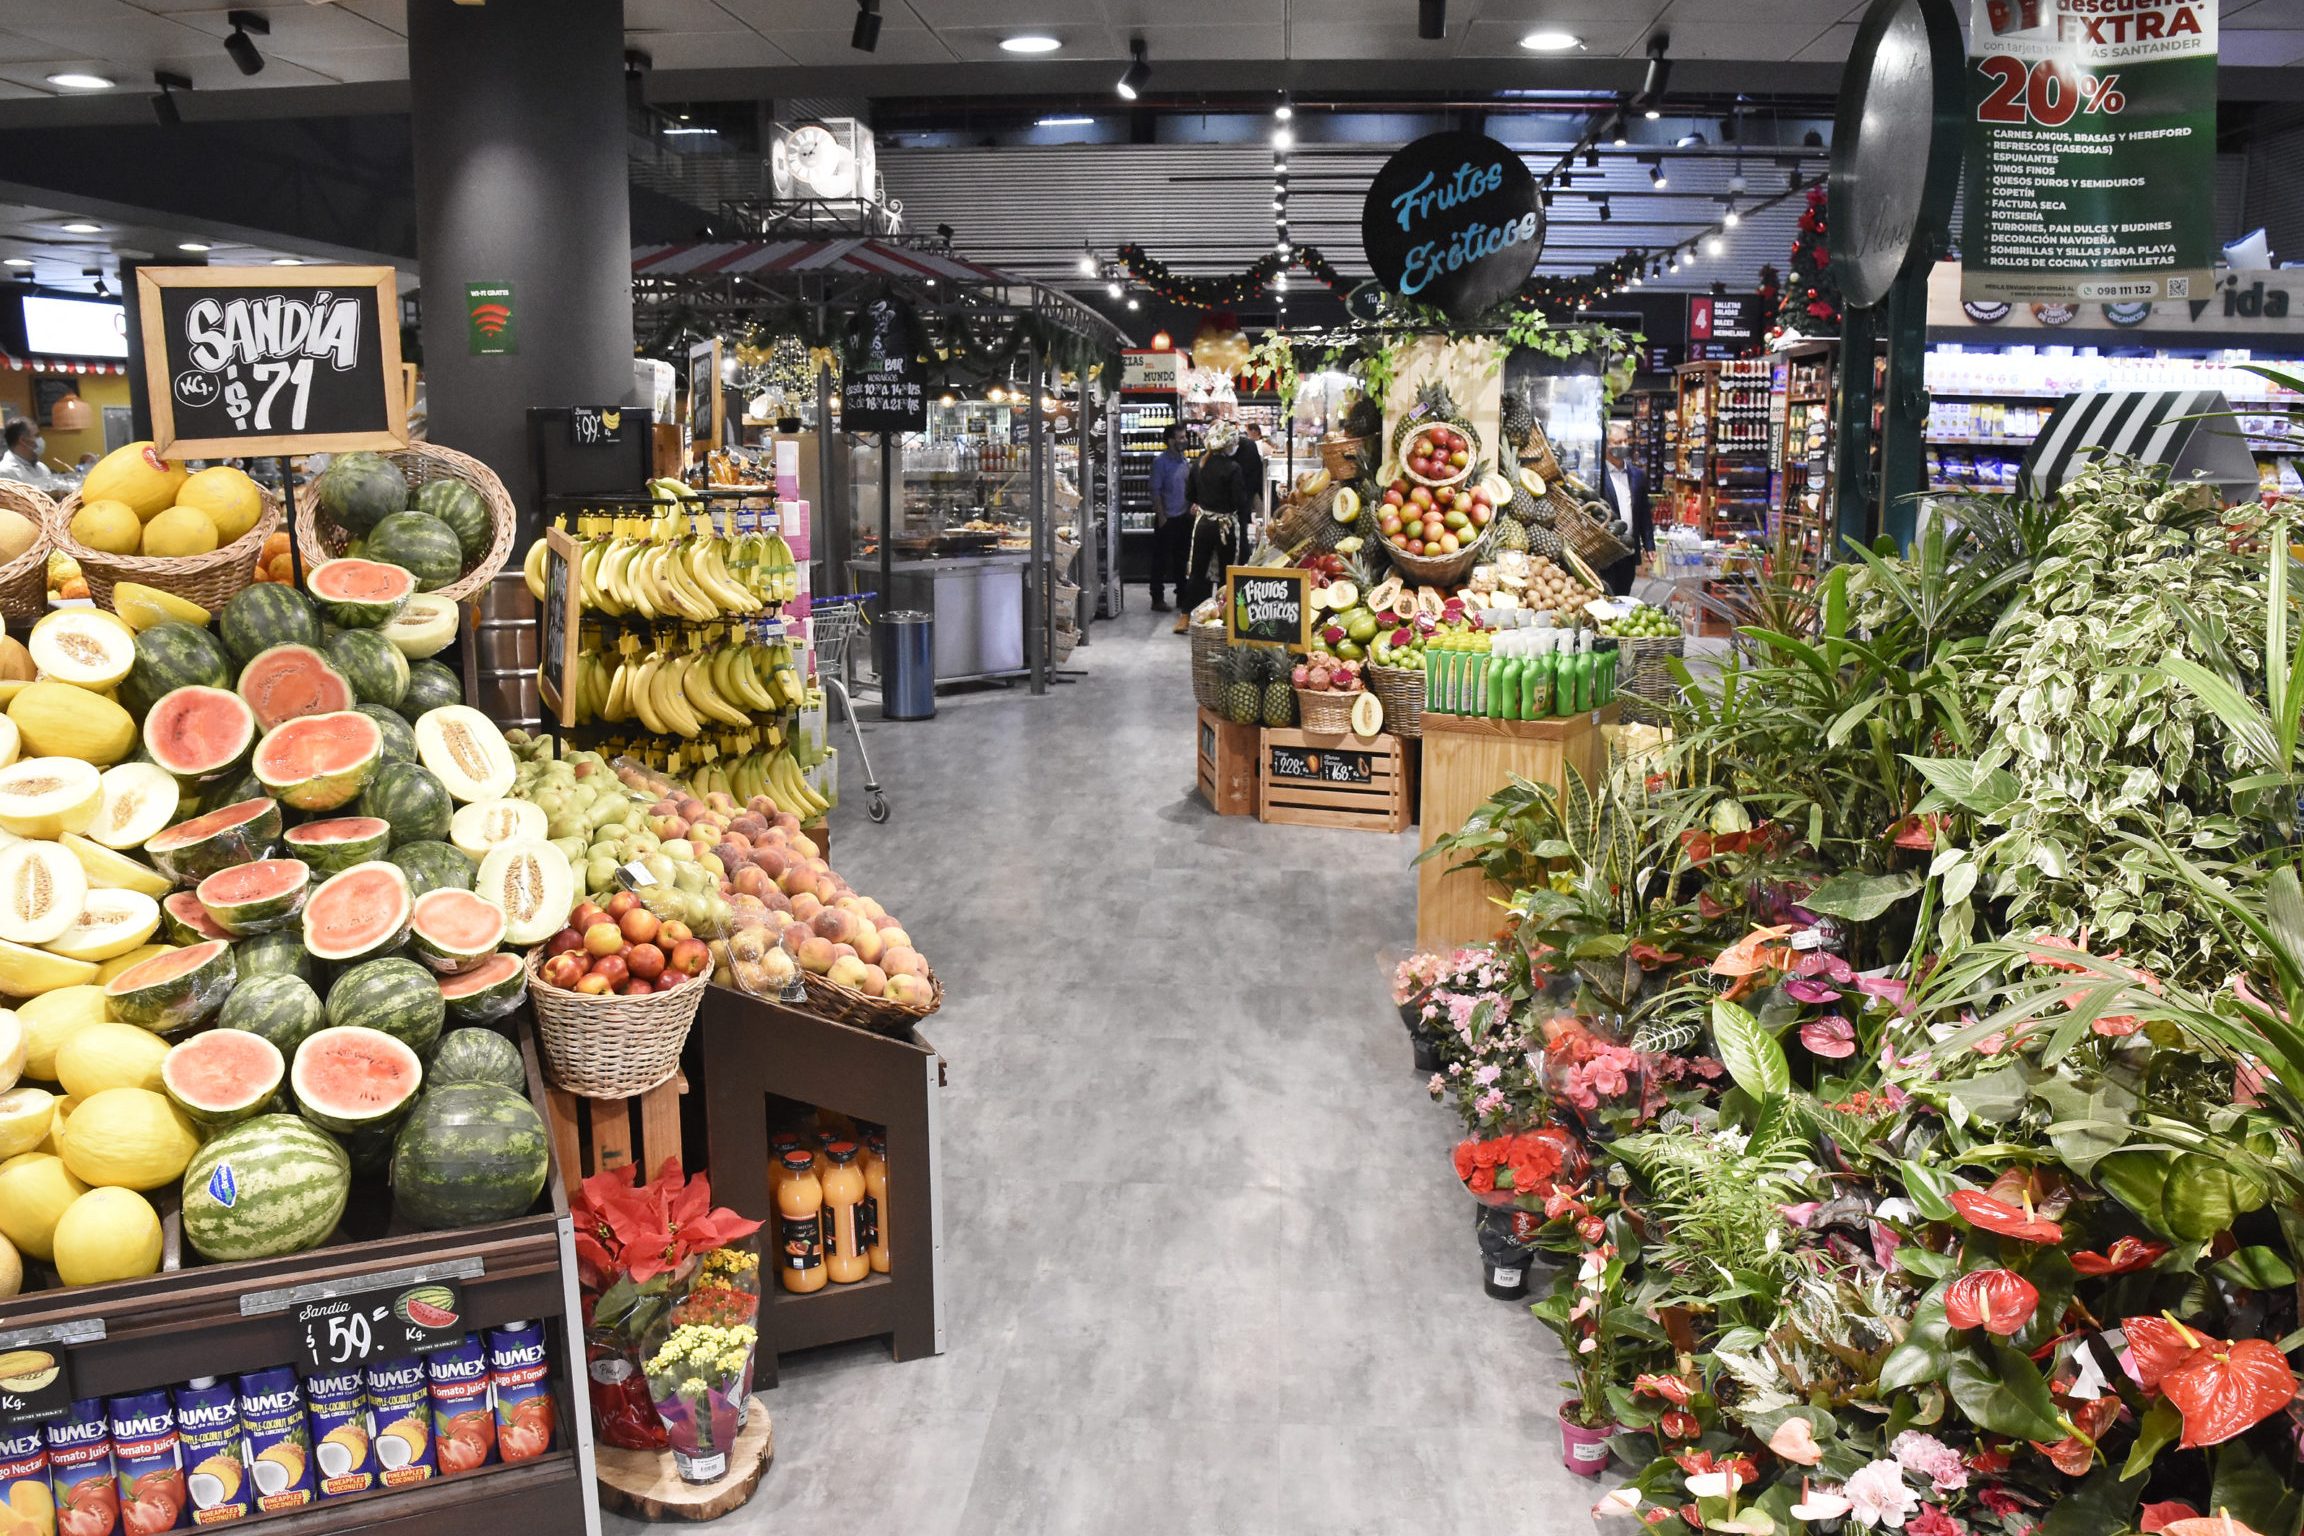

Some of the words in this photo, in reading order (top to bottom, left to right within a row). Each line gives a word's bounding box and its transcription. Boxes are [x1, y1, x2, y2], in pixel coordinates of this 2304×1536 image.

[1983, 42, 2004, 50] con
[2112, 38, 2200, 56] SANTANDER
[1977, 54, 2126, 127] 20%
[1993, 130, 2033, 140] CARNES
[2035, 132, 2072, 142] ANGUS,
[2074, 132, 2116, 142] BRASAS
[2128, 128, 2192, 140] HEREFORD
[1993, 142, 2050, 152] REFRESCOS
[2052, 144, 2113, 155] (GASEOSAS)
[1993, 152, 2059, 164] ESPUMANTES
[1993, 164, 2024, 174] VINOS
[2026, 166, 2056, 175] FINOS
[1992, 176, 2032, 186] QUESOS
[2034, 178, 2070, 187] DUROS
[2071, 179, 2078, 188] Y
[2080, 178, 2146, 188] SEMIDUROS
[1392, 162, 1502, 232] Frutos
[1992, 187, 2035, 197] COPETÍN
[1992, 199, 2038, 208] FACTURA
[2040, 202, 2067, 210] SECA
[1992, 211, 2044, 220] ROTISERÍA
[1992, 222, 2046, 233] TURRONES,
[2049, 224, 2070, 232] PAN
[2074, 224, 2108, 233] DULCE
[2111, 224, 2118, 233] Y
[2122, 222, 2172, 232] BUDINES
[1991, 234, 2057, 244] DECORACIÓN
[2060, 234, 2116, 244] NAVIDEÑA
[1400, 212, 1536, 295] Exóticos
[1990, 246, 2054, 256] SOMBRILLAS
[2056, 248, 2064, 256] Y
[2066, 248, 2102, 256] SILLAS
[2104, 246, 2135, 256] PARA
[2138, 244, 2176, 254] PLAYA
[1990, 257, 2030, 266] ROLLOS
[2032, 258, 2046, 266] DE
[2048, 259, 2088, 267] COCINA
[2091, 259, 2098, 267] Y
[2100, 256, 2175, 268] SERVILLETAS
[2097, 286, 2117, 296] 098
[2119, 286, 2132, 295] 111
[2134, 286, 2152, 294] 132
[1695, 308, 1707, 330] 4
[2047, 312, 2073, 324] GLUTEN
[186, 290, 360, 372] SANDÍA
[1692, 344, 1701, 359] 2
[884, 358, 904, 374] BAR
[1144, 371, 1175, 382] MUNDO
[1771, 424, 1780, 451] DULCE
[1244, 580, 1288, 604] FRUTOS
[300, 1301, 351, 1322] Sandía
[406, 1326, 426, 1342] Kg.
[491, 1339, 546, 1366] JUMEX
[428, 1354, 486, 1379] JUMEX
[308, 1368, 362, 1394] JUMEX
[368, 1362, 425, 1388] JUMEX
[495, 1374, 510, 1386] Jugo
[512, 1372, 521, 1382] de
[432, 1385, 465, 1396] Tomato
[466, 1381, 486, 1396] Juice
[2, 1394, 26, 1410] Kg.
[241, 1384, 300, 1412] JUMEX
[178, 1398, 237, 1426] JUMEX
[288, 1410, 304, 1425] NECTAR
[47, 1414, 110, 1444] JUMEX
[112, 1408, 174, 1436] JUMEX
[224, 1424, 240, 1440] NECTAR
[50, 1450, 86, 1464] Tomato
[88, 1444, 110, 1460] Juice
[116, 1443, 151, 1456] Tomato
[153, 1438, 175, 1452] Juice
[12, 1458, 43, 1474] Nectar
[388, 1468, 424, 1480] PINEAPPLES
[328, 1476, 365, 1487] PINEAPPLES
[264, 1494, 302, 1504] PINEAPPLES
[200, 1508, 238, 1518] PINEAPPLES
